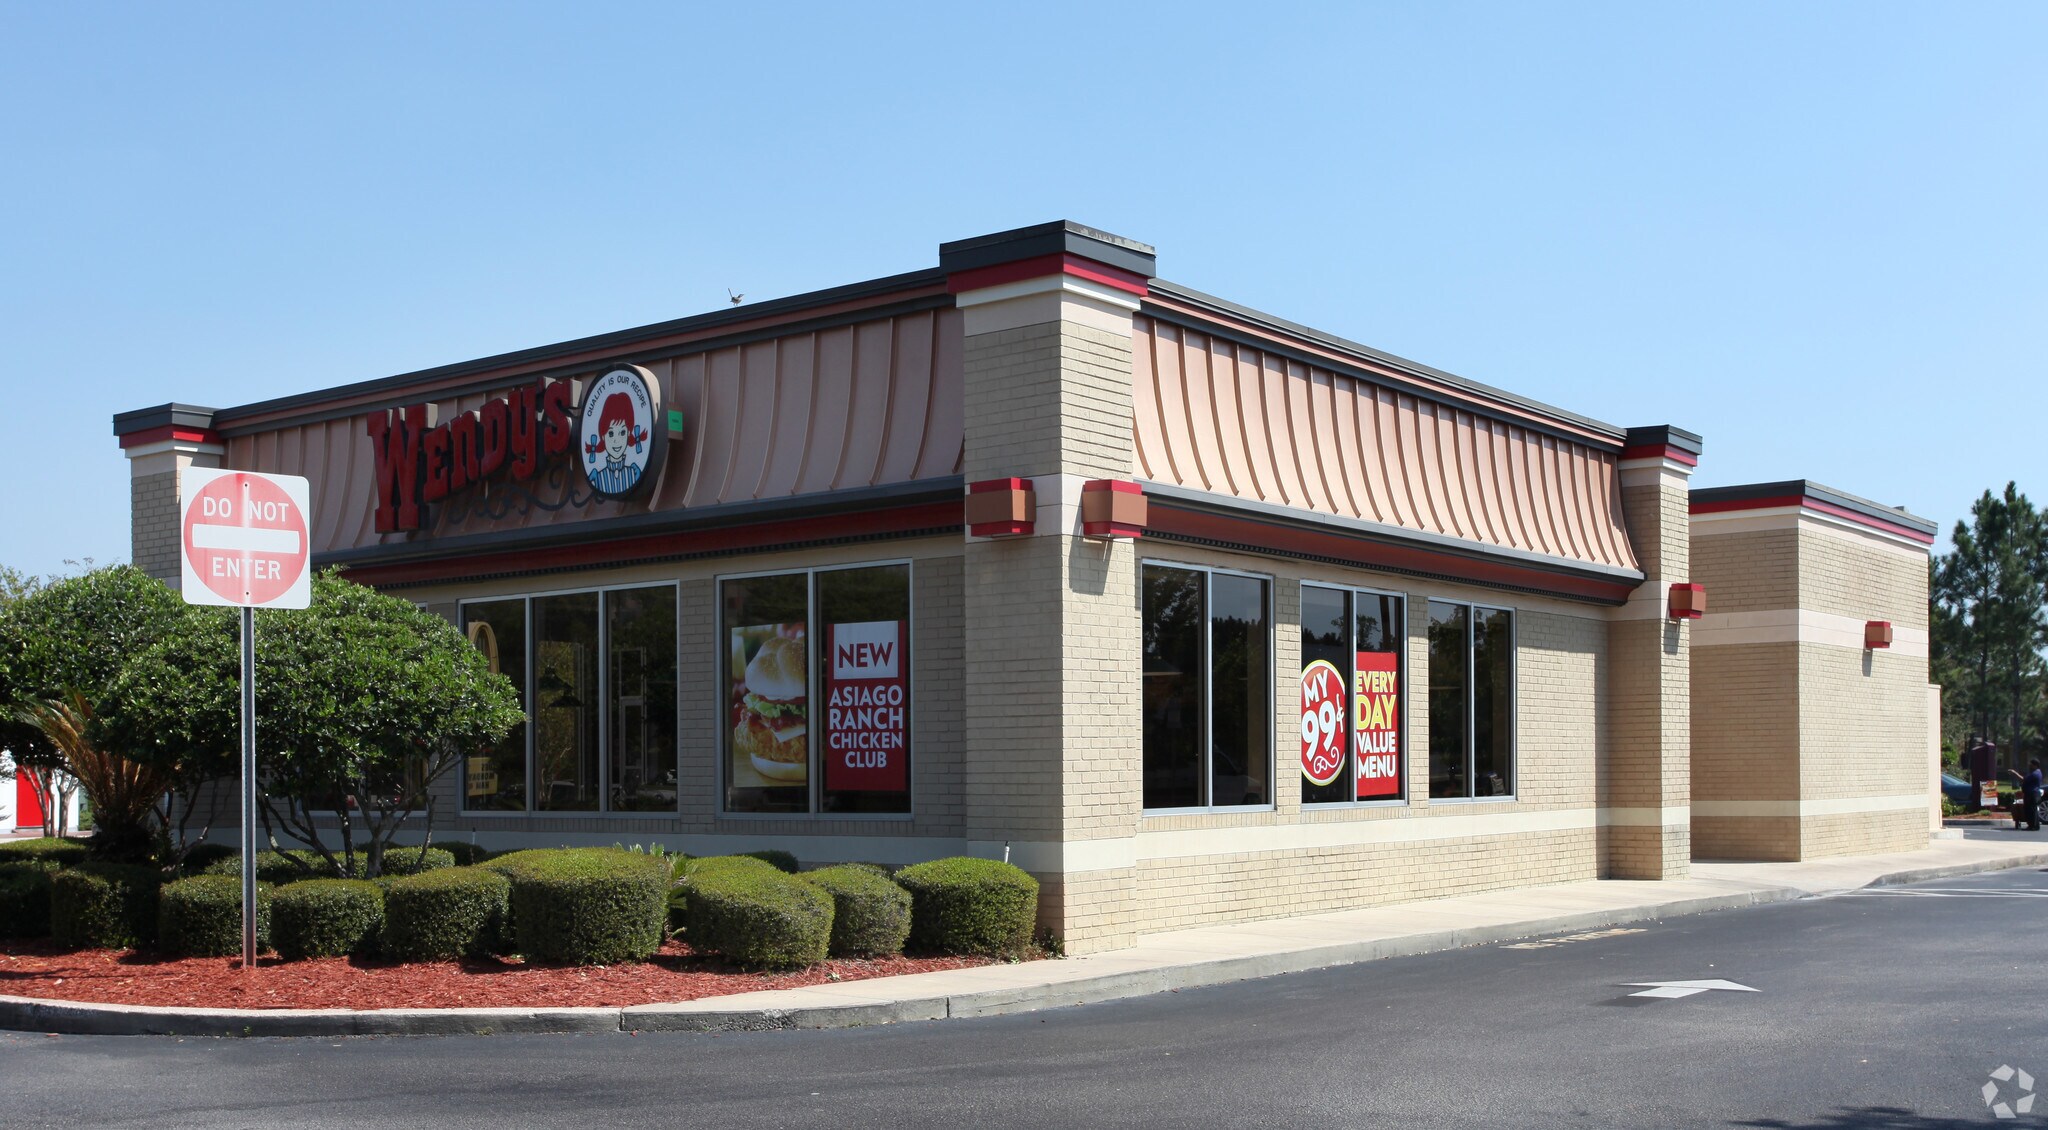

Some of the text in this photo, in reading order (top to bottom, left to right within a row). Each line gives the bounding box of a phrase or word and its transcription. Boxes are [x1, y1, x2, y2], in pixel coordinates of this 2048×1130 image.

[587, 375, 647, 417] QUALITY IS OUR RECIPE
[203, 496, 289, 522] DO NOT
[212, 556, 281, 580] ENTER
[838, 641, 894, 669] NEW
[1303, 669, 1329, 708] MY
[1355, 670, 1397, 693] EVERY
[829, 684, 903, 707] ASIAGO
[829, 707, 904, 730] RANCH
[1356, 694, 1397, 730] DAY
[829, 731, 903, 749] CHICKEN
[1356, 731, 1396, 754] VALUE
[845, 751, 887, 768] CLUB
[1358, 755, 1396, 779] MENU
